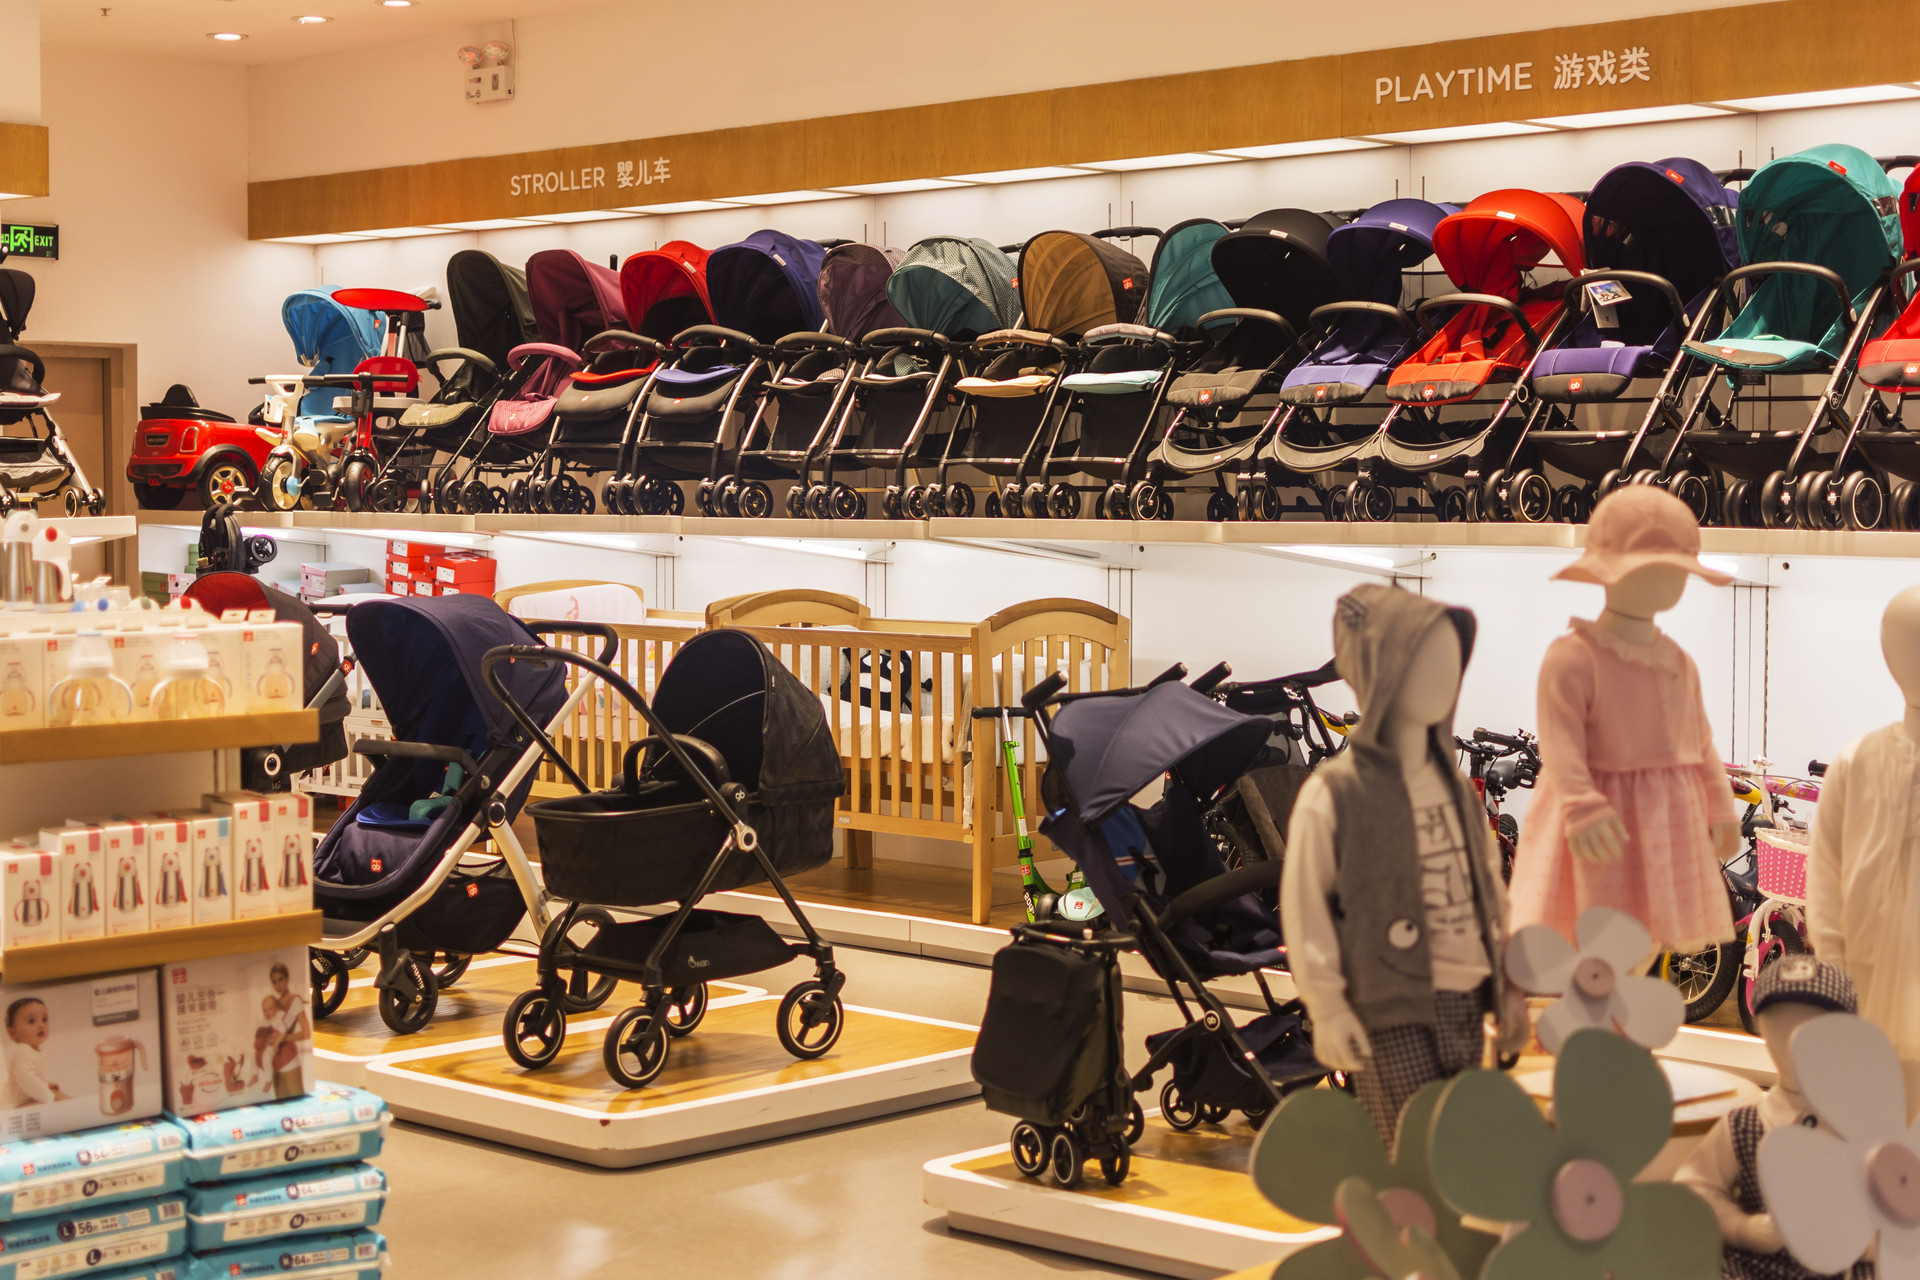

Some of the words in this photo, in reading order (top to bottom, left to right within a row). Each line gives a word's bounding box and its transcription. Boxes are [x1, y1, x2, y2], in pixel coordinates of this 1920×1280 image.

[1375, 62, 1533, 105] PLAYTIME
[1553, 46, 1651, 90] 游戏类
[510, 166, 606, 196] STROLLER
[617, 156, 672, 189] 婴儿车
[34, 235, 54, 247] EXIT
[735, 789, 745, 802] gb
